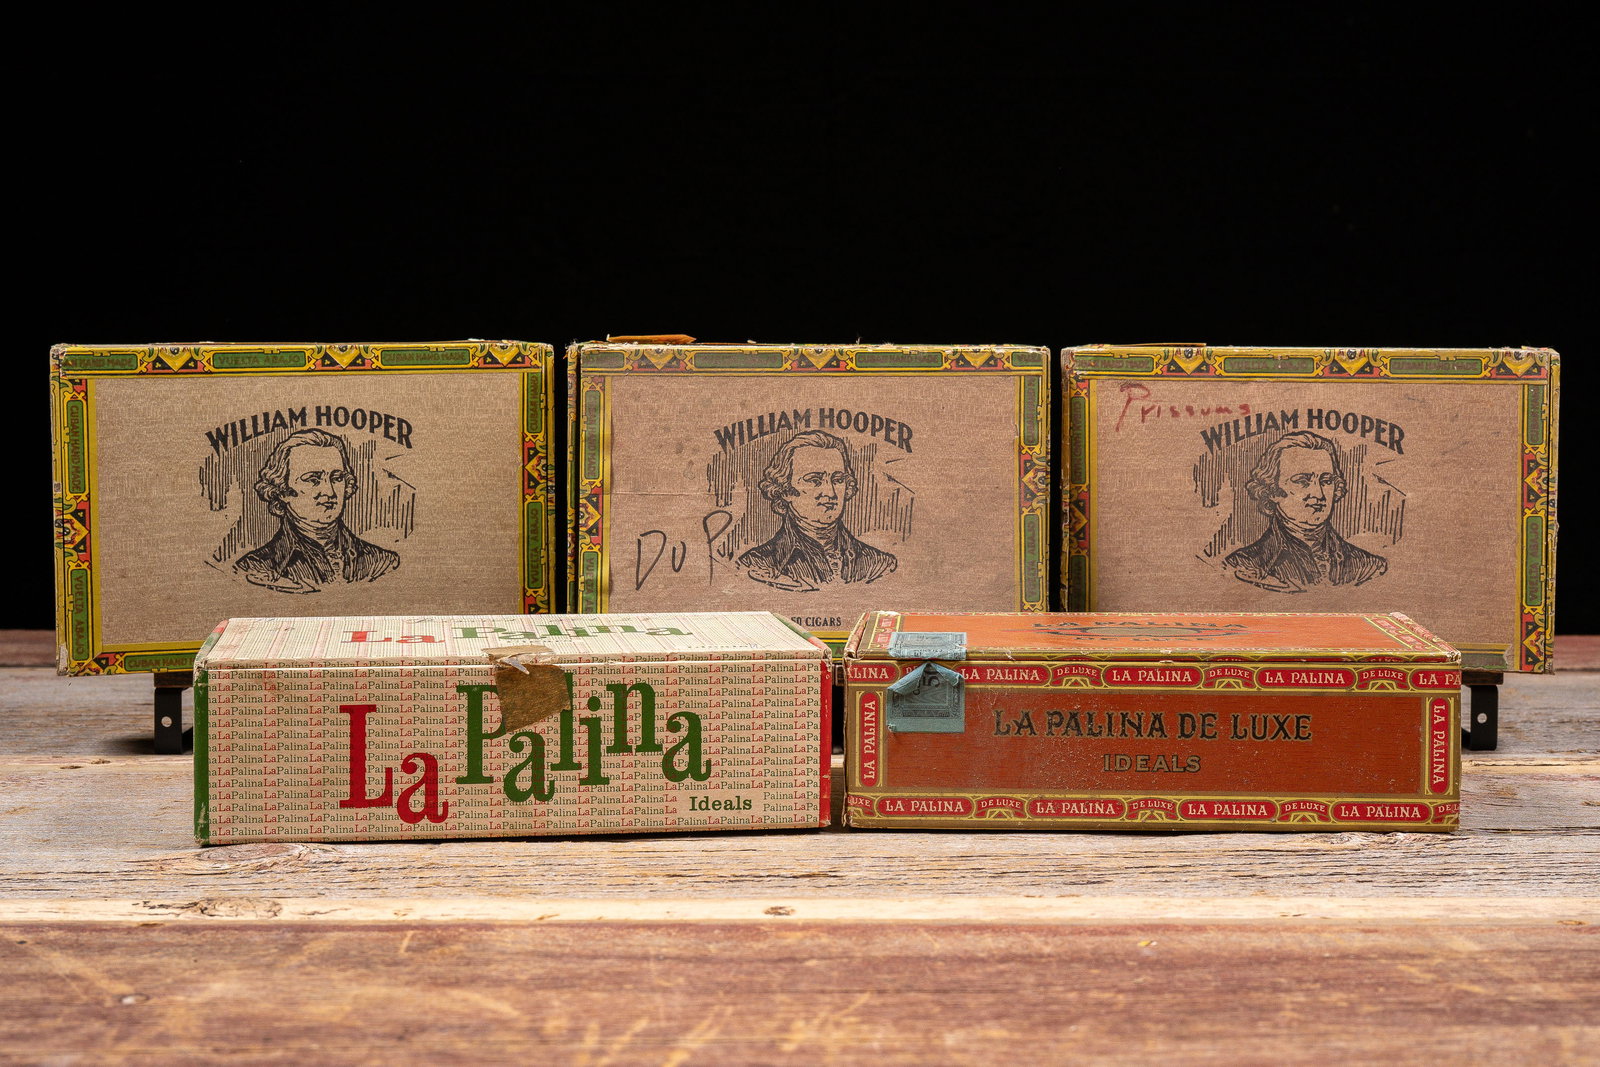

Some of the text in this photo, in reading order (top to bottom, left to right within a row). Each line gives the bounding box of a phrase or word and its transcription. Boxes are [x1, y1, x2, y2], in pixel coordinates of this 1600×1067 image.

[70, 405, 82, 492] CUBAN HAND MADE
[205, 406, 412, 457] WILLIAM HOOPER
[714, 408, 913, 454] WILLIAM HOOPER
[1200, 409, 1405, 455] WILLIAM HOOPER
[74, 576, 86, 655] VUELTA ABAJO
[341, 624, 693, 644] La Palina
[805, 616, 842, 627] CIGARS
[848, 667, 887, 680] ALINA
[962, 668, 980, 680] LA
[986, 668, 1040, 681] PALINA
[1057, 668, 1070, 676] DE
[1072, 667, 1097, 677] LUXE
[1112, 669, 1131, 682] LA
[1138, 669, 1192, 682] PALINA
[1209, 669, 1222, 678] DE
[1225, 668, 1250, 678] LUXE
[1265, 671, 1285, 683] LA
[1291, 671, 1346, 684] PALINA
[1362, 671, 1376, 679] DE
[1378, 669, 1403, 680] LUXE
[1418, 673, 1439, 685] LA
[340, 673, 712, 823] La Palina
[864, 700, 876, 779] LA PALINA
[993, 710, 1312, 741] LA PALINA DE LUXE
[1433, 705, 1446, 784] LA PALINA
[1103, 753, 1202, 773] IDEALS
[689, 795, 752, 811] Ideals
[885, 800, 904, 812] LA
[911, 800, 964, 812] PALINA
[981, 800, 993, 808] DE
[996, 799, 1021, 808] LUXE
[1036, 802, 1056, 814] LA
[1062, 802, 1116, 814] PALINA
[1132, 802, 1145, 810] DE
[1148, 800, 1174, 811] LUXE
[1188, 804, 1207, 815] LA
[1213, 804, 1268, 816] PALINA
[1285, 803, 1298, 811] DE
[1300, 802, 1326, 812] LUXE
[1341, 805, 1360, 817] LA
[1367, 806, 1421, 818] PALINA
[1438, 805, 1451, 813] DE
